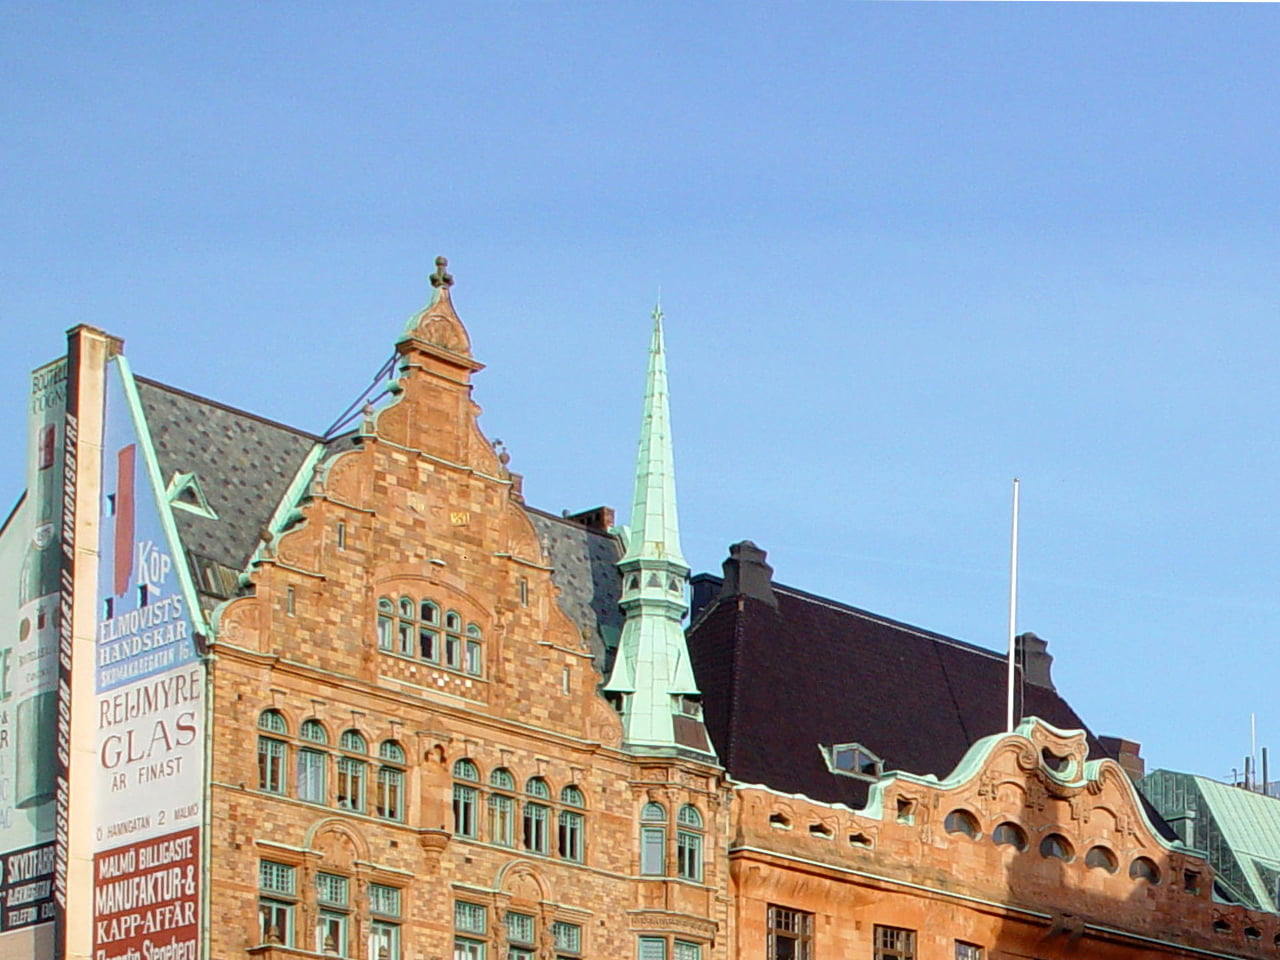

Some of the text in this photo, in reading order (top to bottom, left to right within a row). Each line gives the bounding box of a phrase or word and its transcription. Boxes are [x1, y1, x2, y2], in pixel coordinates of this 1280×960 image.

[100, 595, 183, 645] ELMQVIST'S
[100, 621, 187, 667] HANDSKAR
[57, 678, 71, 768] GENOM
[99, 670, 200, 729] REIJMYRE
[101, 712, 197, 769] GLAS
[138, 757, 183, 784] FINAST
[55, 775, 69, 909] ANNONSERA
[158, 810, 166, 826] 2
[99, 836, 193, 880] MALMÖ BILLIGASTE
[96, 901, 196, 945] KAPP-AFFÄR
